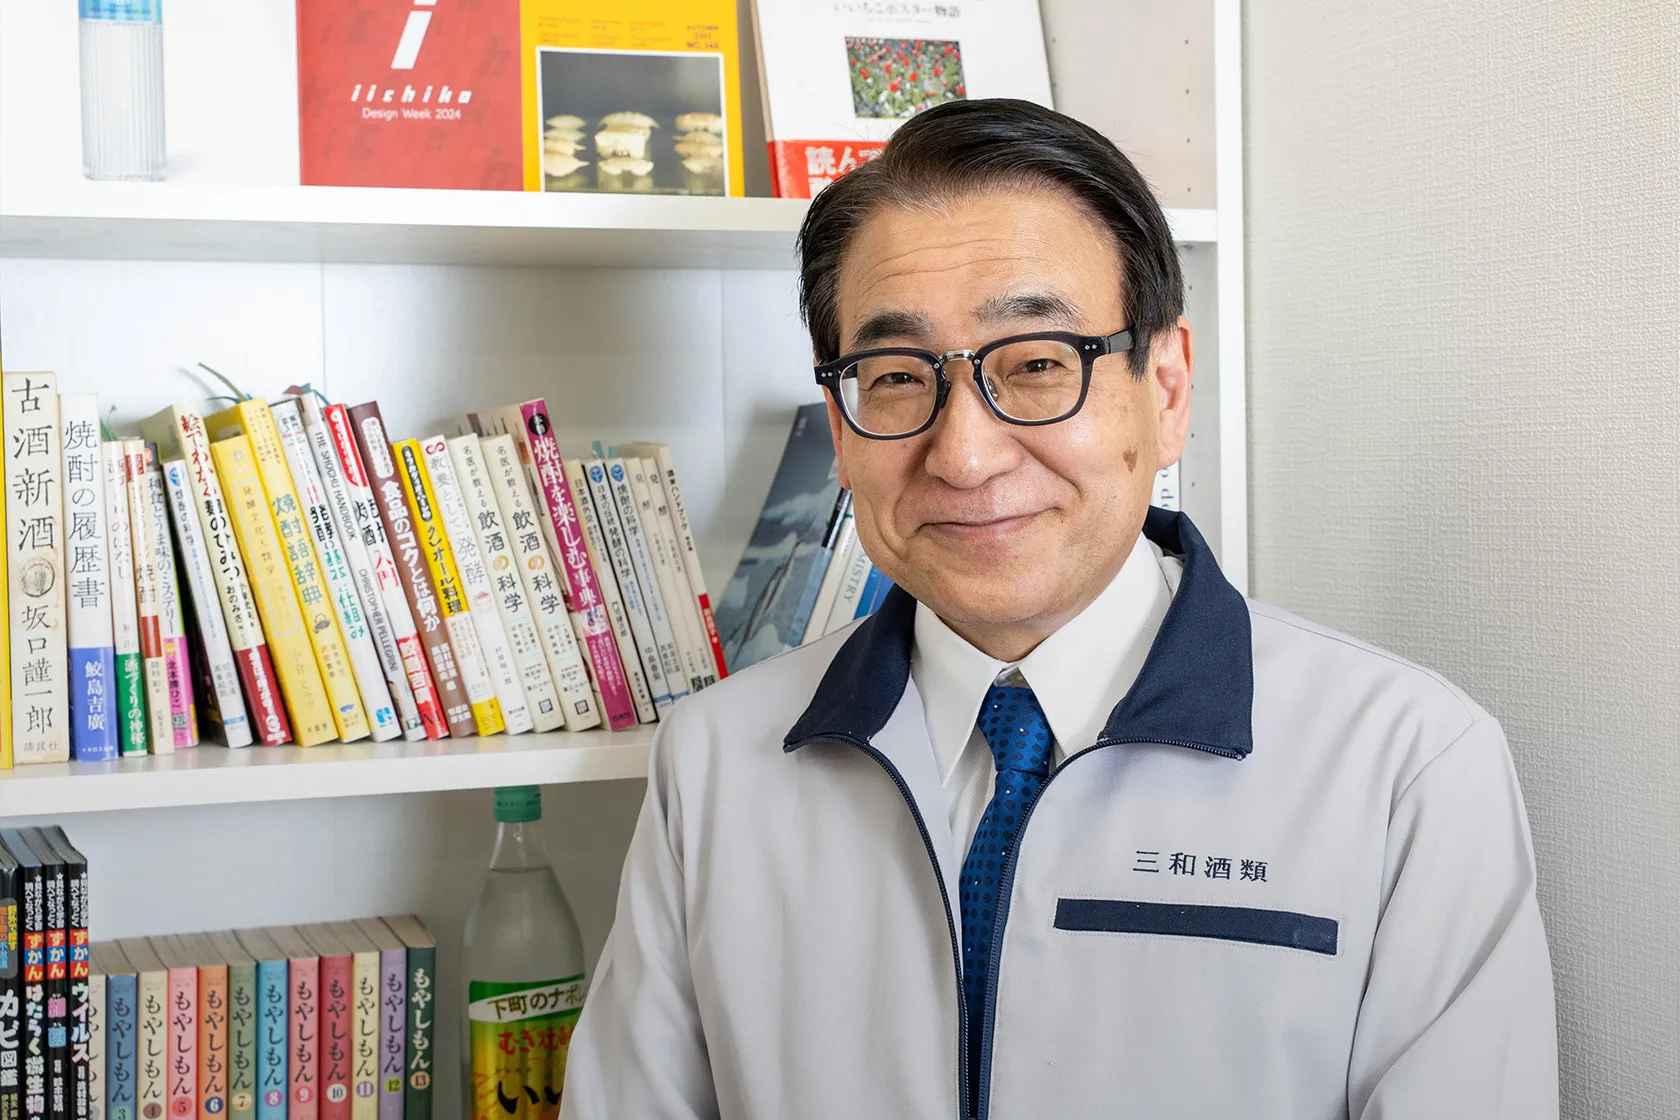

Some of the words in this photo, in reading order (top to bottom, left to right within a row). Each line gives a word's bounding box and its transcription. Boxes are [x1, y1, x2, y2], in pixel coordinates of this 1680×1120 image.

[351, 84, 472, 104] iichiko
[362, 107, 398, 122] Design
[402, 108, 431, 120] Week
[435, 108, 461, 120] 2024
[12, 378, 54, 551] 古酒新酒
[64, 420, 106, 608] 焼酎の履歴書
[315, 431, 324, 449] THE
[321, 450, 340, 488] SHOCHU
[334, 488, 358, 540] HANDBOOK
[463, 444, 487, 508] 名医が教える
[496, 445, 523, 509] 名医が教える
[574, 478, 594, 523] 日本酒外交
[616, 483, 639, 537] 焼酎の科学
[149, 476, 175, 635] 和食とうま味のミステリー
[272, 494, 323, 606] 焼酎語辞典
[353, 496, 400, 591] 焼酎入門
[380, 479, 441, 633] 食品のコクとは何か
[427, 524, 464, 614] クレオール料理
[478, 510, 524, 613] 飲酒の科学
[511, 510, 561, 616] 飲酒の科学
[532, 436, 598, 607] 焼酎を楽しむ事典
[359, 568, 384, 626] CHRISTOPHER
[376, 625, 399, 672] PELLEGRINI
[843, 551, 867, 604] MISTRY
[21, 605, 53, 734] 坂口謹一郎
[84, 660, 105, 731] 鮫島吉廣
[124, 658, 145, 745] 酒づくりの神秘
[1132, 850, 1269, 883] 三和酒類
[27, 933, 43, 981] ずかん
[49, 931, 65, 978] ずかん
[73, 930, 88, 977] ずかん
[0, 989, 19, 1087] カビ図鑑
[25, 984, 45, 1114] はたらく微生物
[71, 982, 90, 1064] ウイルス
[111, 997, 132, 1103] もやしもん
[142, 994, 162, 1099] もやしもん
[173, 991, 192, 1095] もやしもん
[204, 989, 224, 1093] もやしもん
[232, 986, 252, 1090] もやしもん
[264, 984, 284, 1086] もやしもん
[295, 981, 314, 1083] もやしもん
[327, 979, 347, 1081] もやしもん
[356, 977, 375, 1078] もやしもん
[383, 973, 403, 1075] もやしもん
[410, 968, 432, 1070] もやしもん
